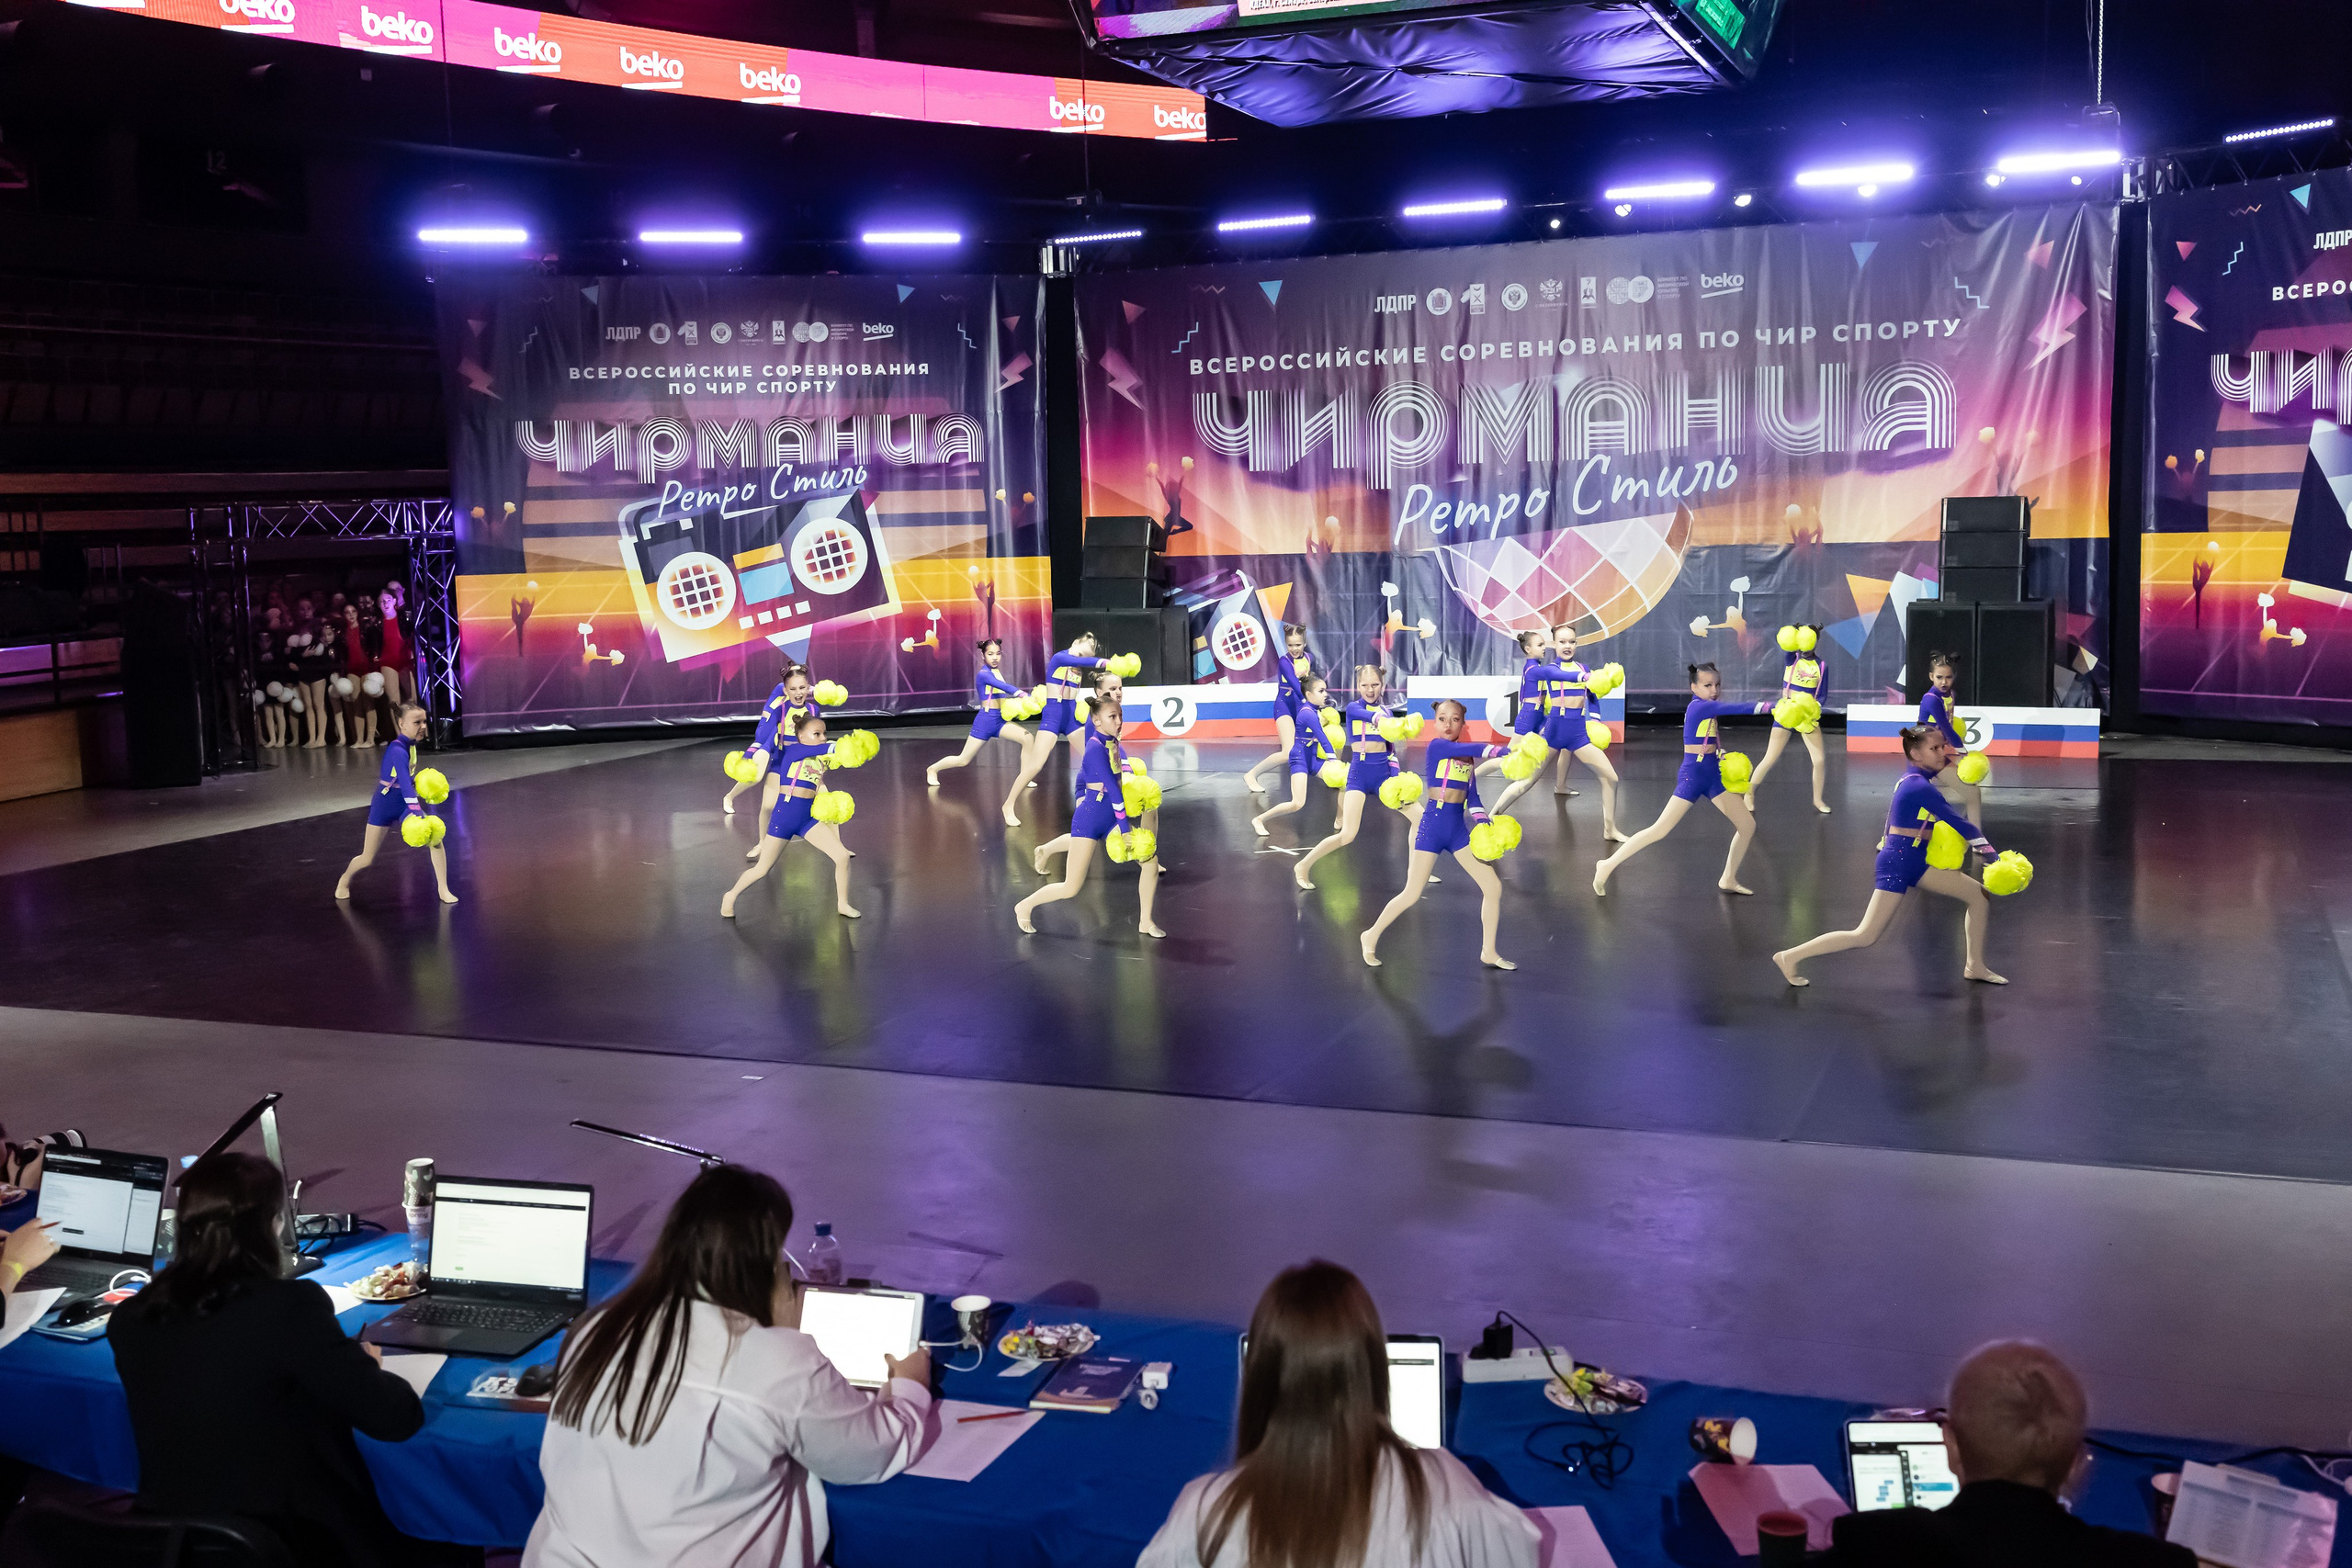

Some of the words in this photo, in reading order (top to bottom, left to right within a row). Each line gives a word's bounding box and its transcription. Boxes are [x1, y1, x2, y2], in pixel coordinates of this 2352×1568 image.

[361, 6, 434, 44] beko
[494, 27, 561, 63] beko
[620, 46, 684, 80] beko
[740, 62, 801, 95] beko
[1049, 96, 1105, 123] beko
[1154, 105, 1206, 130] beko
[1702, 273, 1744, 288] beko
[2272, 280, 2352, 301] ВСЕРО
[1374, 294, 1417, 314] ЛДПР
[605, 326, 641, 342] ЛДПР
[863, 322, 894, 334] beko
[1190, 347, 1427, 375] ВСЕРОССИЙСКИЕ
[1441, 333, 1682, 362] СОРЕВНОВАНИЯ
[1700, 330, 1740, 348] ПО
[1756, 326, 1817, 346] ЧИР
[1833, 319, 1962, 342] СПОРТУ
[569, 363, 752, 379] ВСЕРОССИЙСКИЕ
[763, 363, 929, 378] СОРЕВНОВАНИЯ
[669, 382, 696, 395] ПО
[706, 381, 747, 394] ЧИР
[756, 380, 837, 394] СПОРТУ
[657, 479, 757, 518] Ретро
[770, 463, 867, 500] Стиль
[1393, 483, 1551, 546] Ретро
[1572, 454, 1738, 515] Стиль
[1161, 696, 1185, 728] 2
[1504, 691, 1519, 727] 1
[1962, 716, 1982, 745] 3
